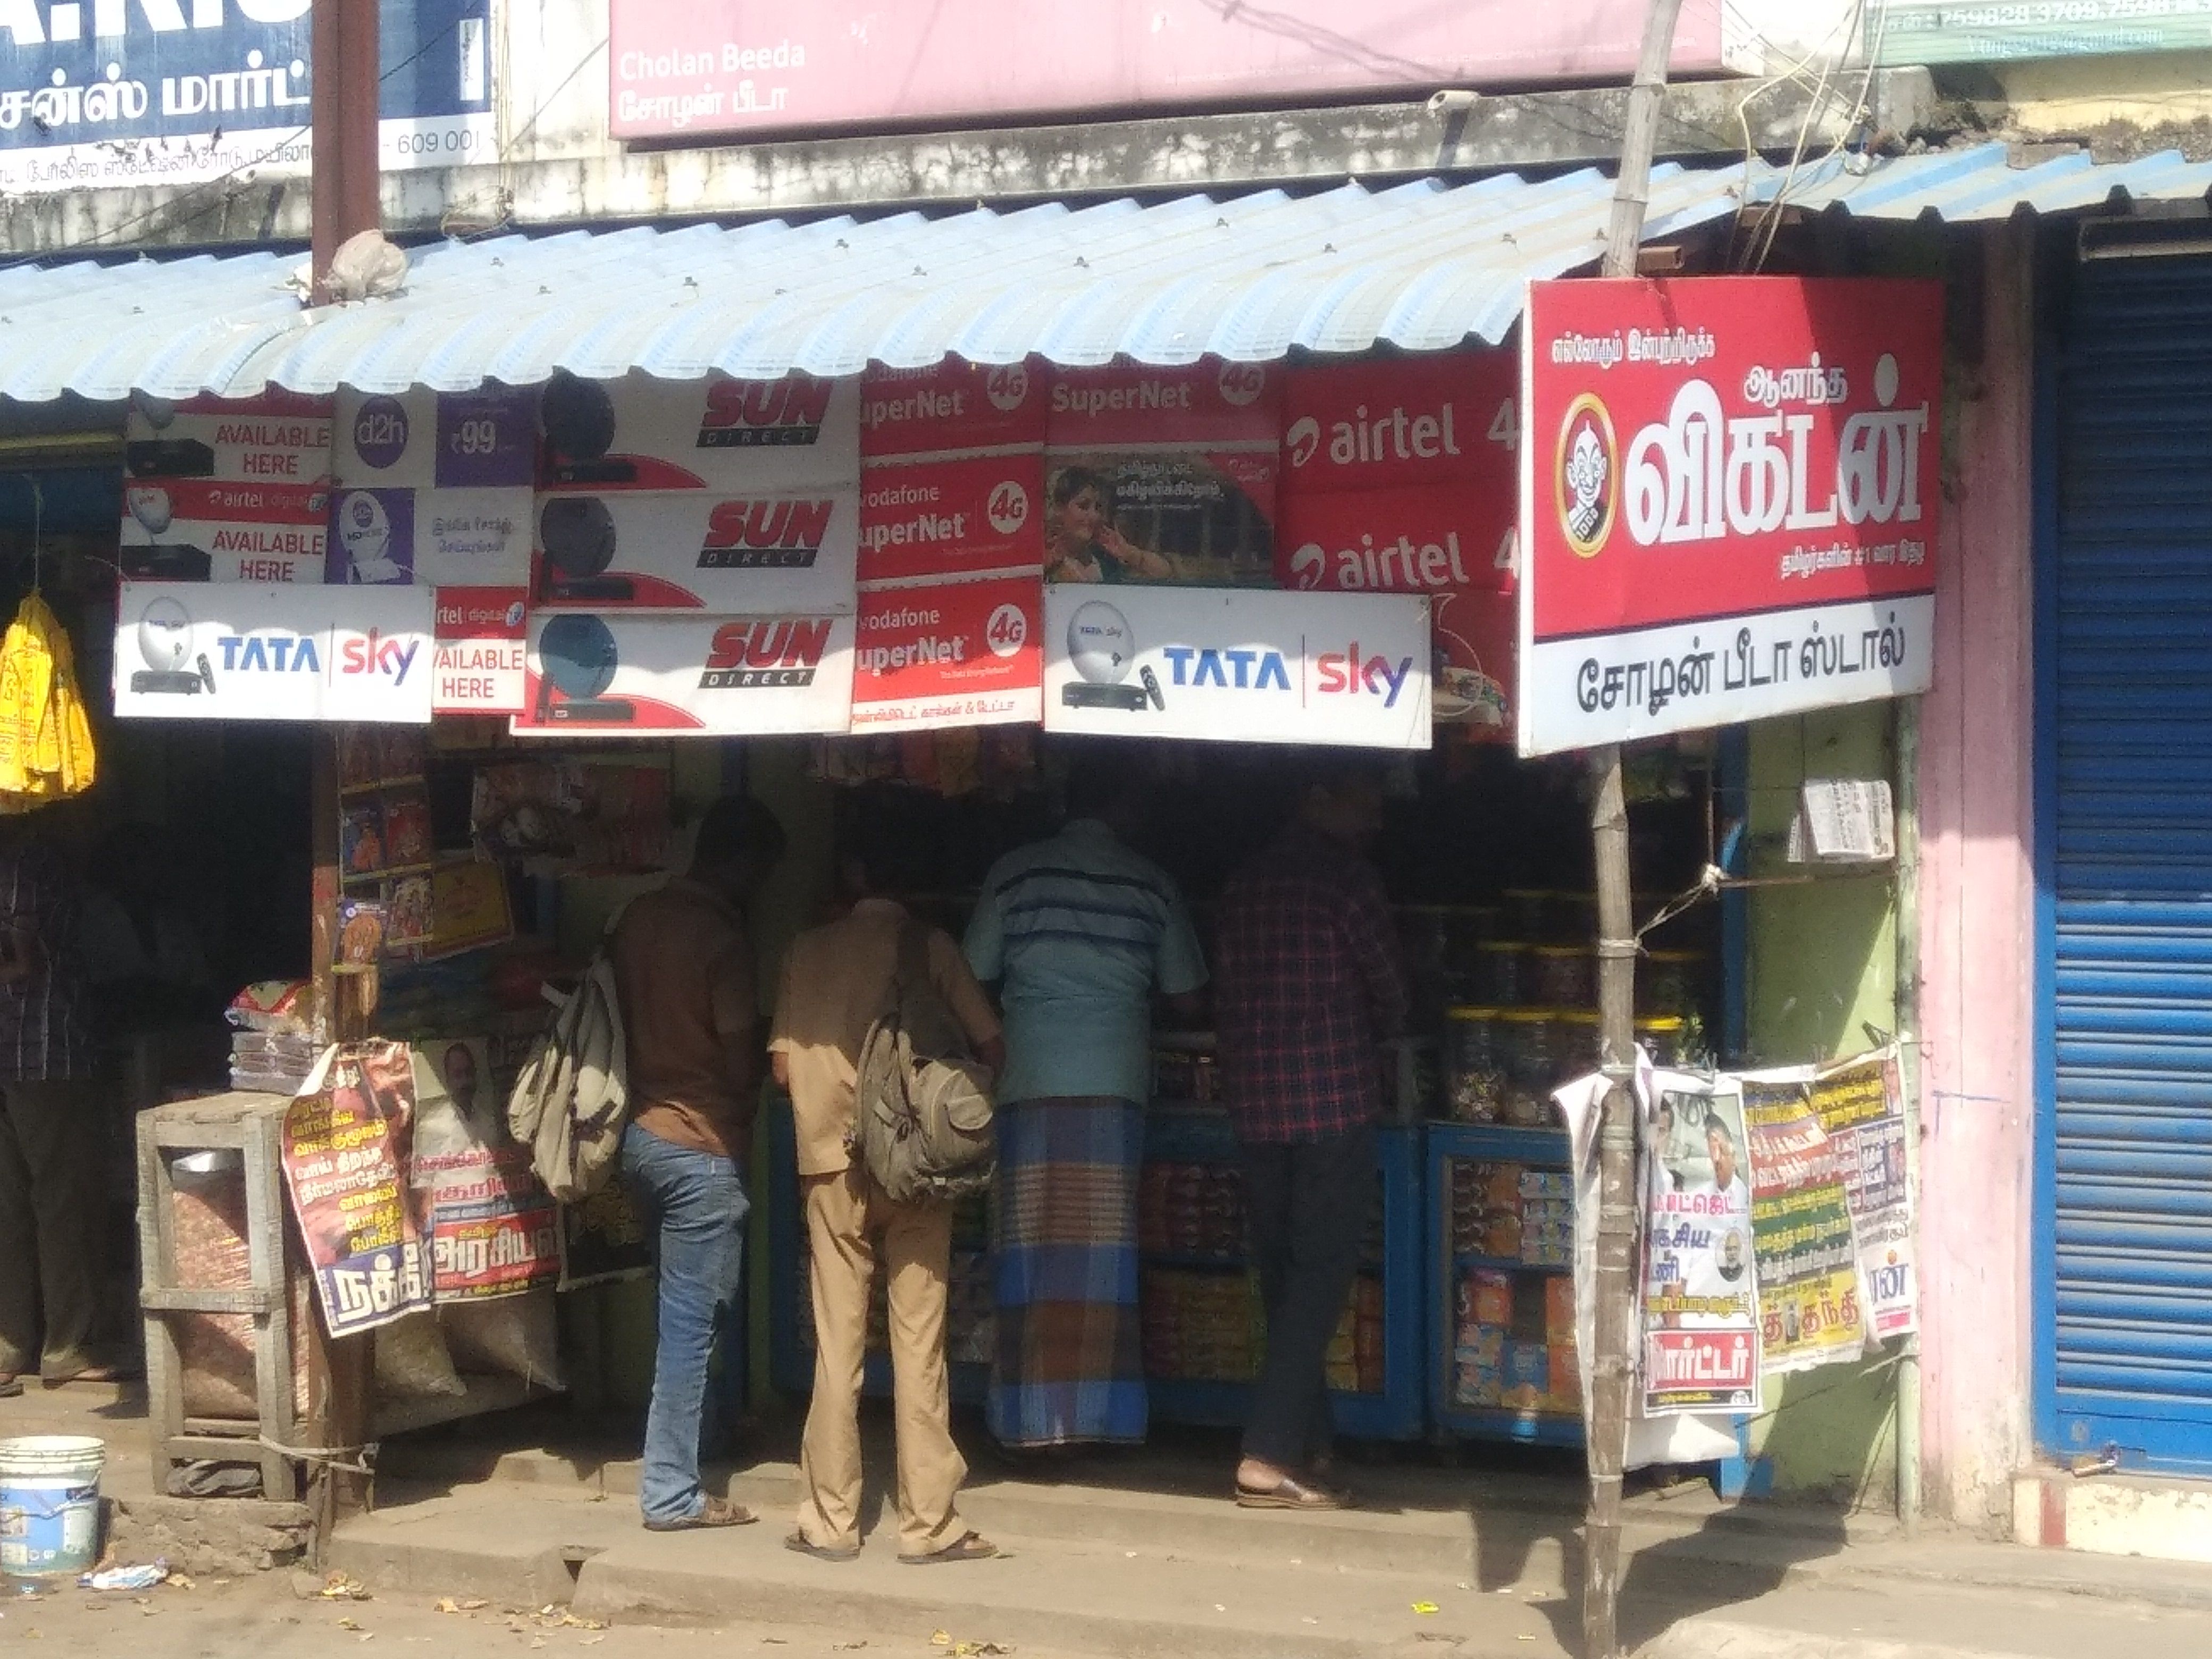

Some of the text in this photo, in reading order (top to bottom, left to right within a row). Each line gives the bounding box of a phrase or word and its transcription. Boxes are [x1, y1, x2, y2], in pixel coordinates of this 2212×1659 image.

[619, 39, 806, 80] Cholan Beeda
[162, 49, 312, 116] மார்ட்
[618, 79, 789, 128] சோழன் பீடா
[398, 132, 439, 155] 609
[445, 129, 480, 153] 001
[1052, 382, 1190, 416] SuperNet
[1744, 351, 1847, 406] ஆனந்த
[703, 378, 833, 426] SUN
[860, 389, 965, 429] uperNet
[215, 424, 329, 450] AVAILABLE
[356, 414, 405, 445] d2h
[706, 429, 809, 445] DIRECT
[1330, 396, 1521, 464] airtel 4
[1625, 353, 1929, 546] விகடன்
[243, 453, 299, 475] HERE
[224, 491, 263, 508] airtel
[213, 531, 324, 555] AVAILABLE
[704, 500, 834, 548] SUN
[858, 513, 965, 553] uperNet
[990, 492, 1024, 521] 4G
[239, 559, 295, 582] HERE
[707, 550, 809, 566] DIRECT
[1338, 526, 1521, 590] airtel 4
[436, 606, 463, 625] rtel
[218, 626, 420, 688] TATA sky
[705, 619, 833, 669] SUN
[857, 635, 965, 677] uperNet
[990, 612, 1024, 643] 4G
[1577, 611, 1906, 716] சோழன் பீடா ஸ்டால்
[442, 677, 495, 698] HERE
[708, 671, 807, 687] DIRECT
[1163, 640, 1414, 708] TATA sky
